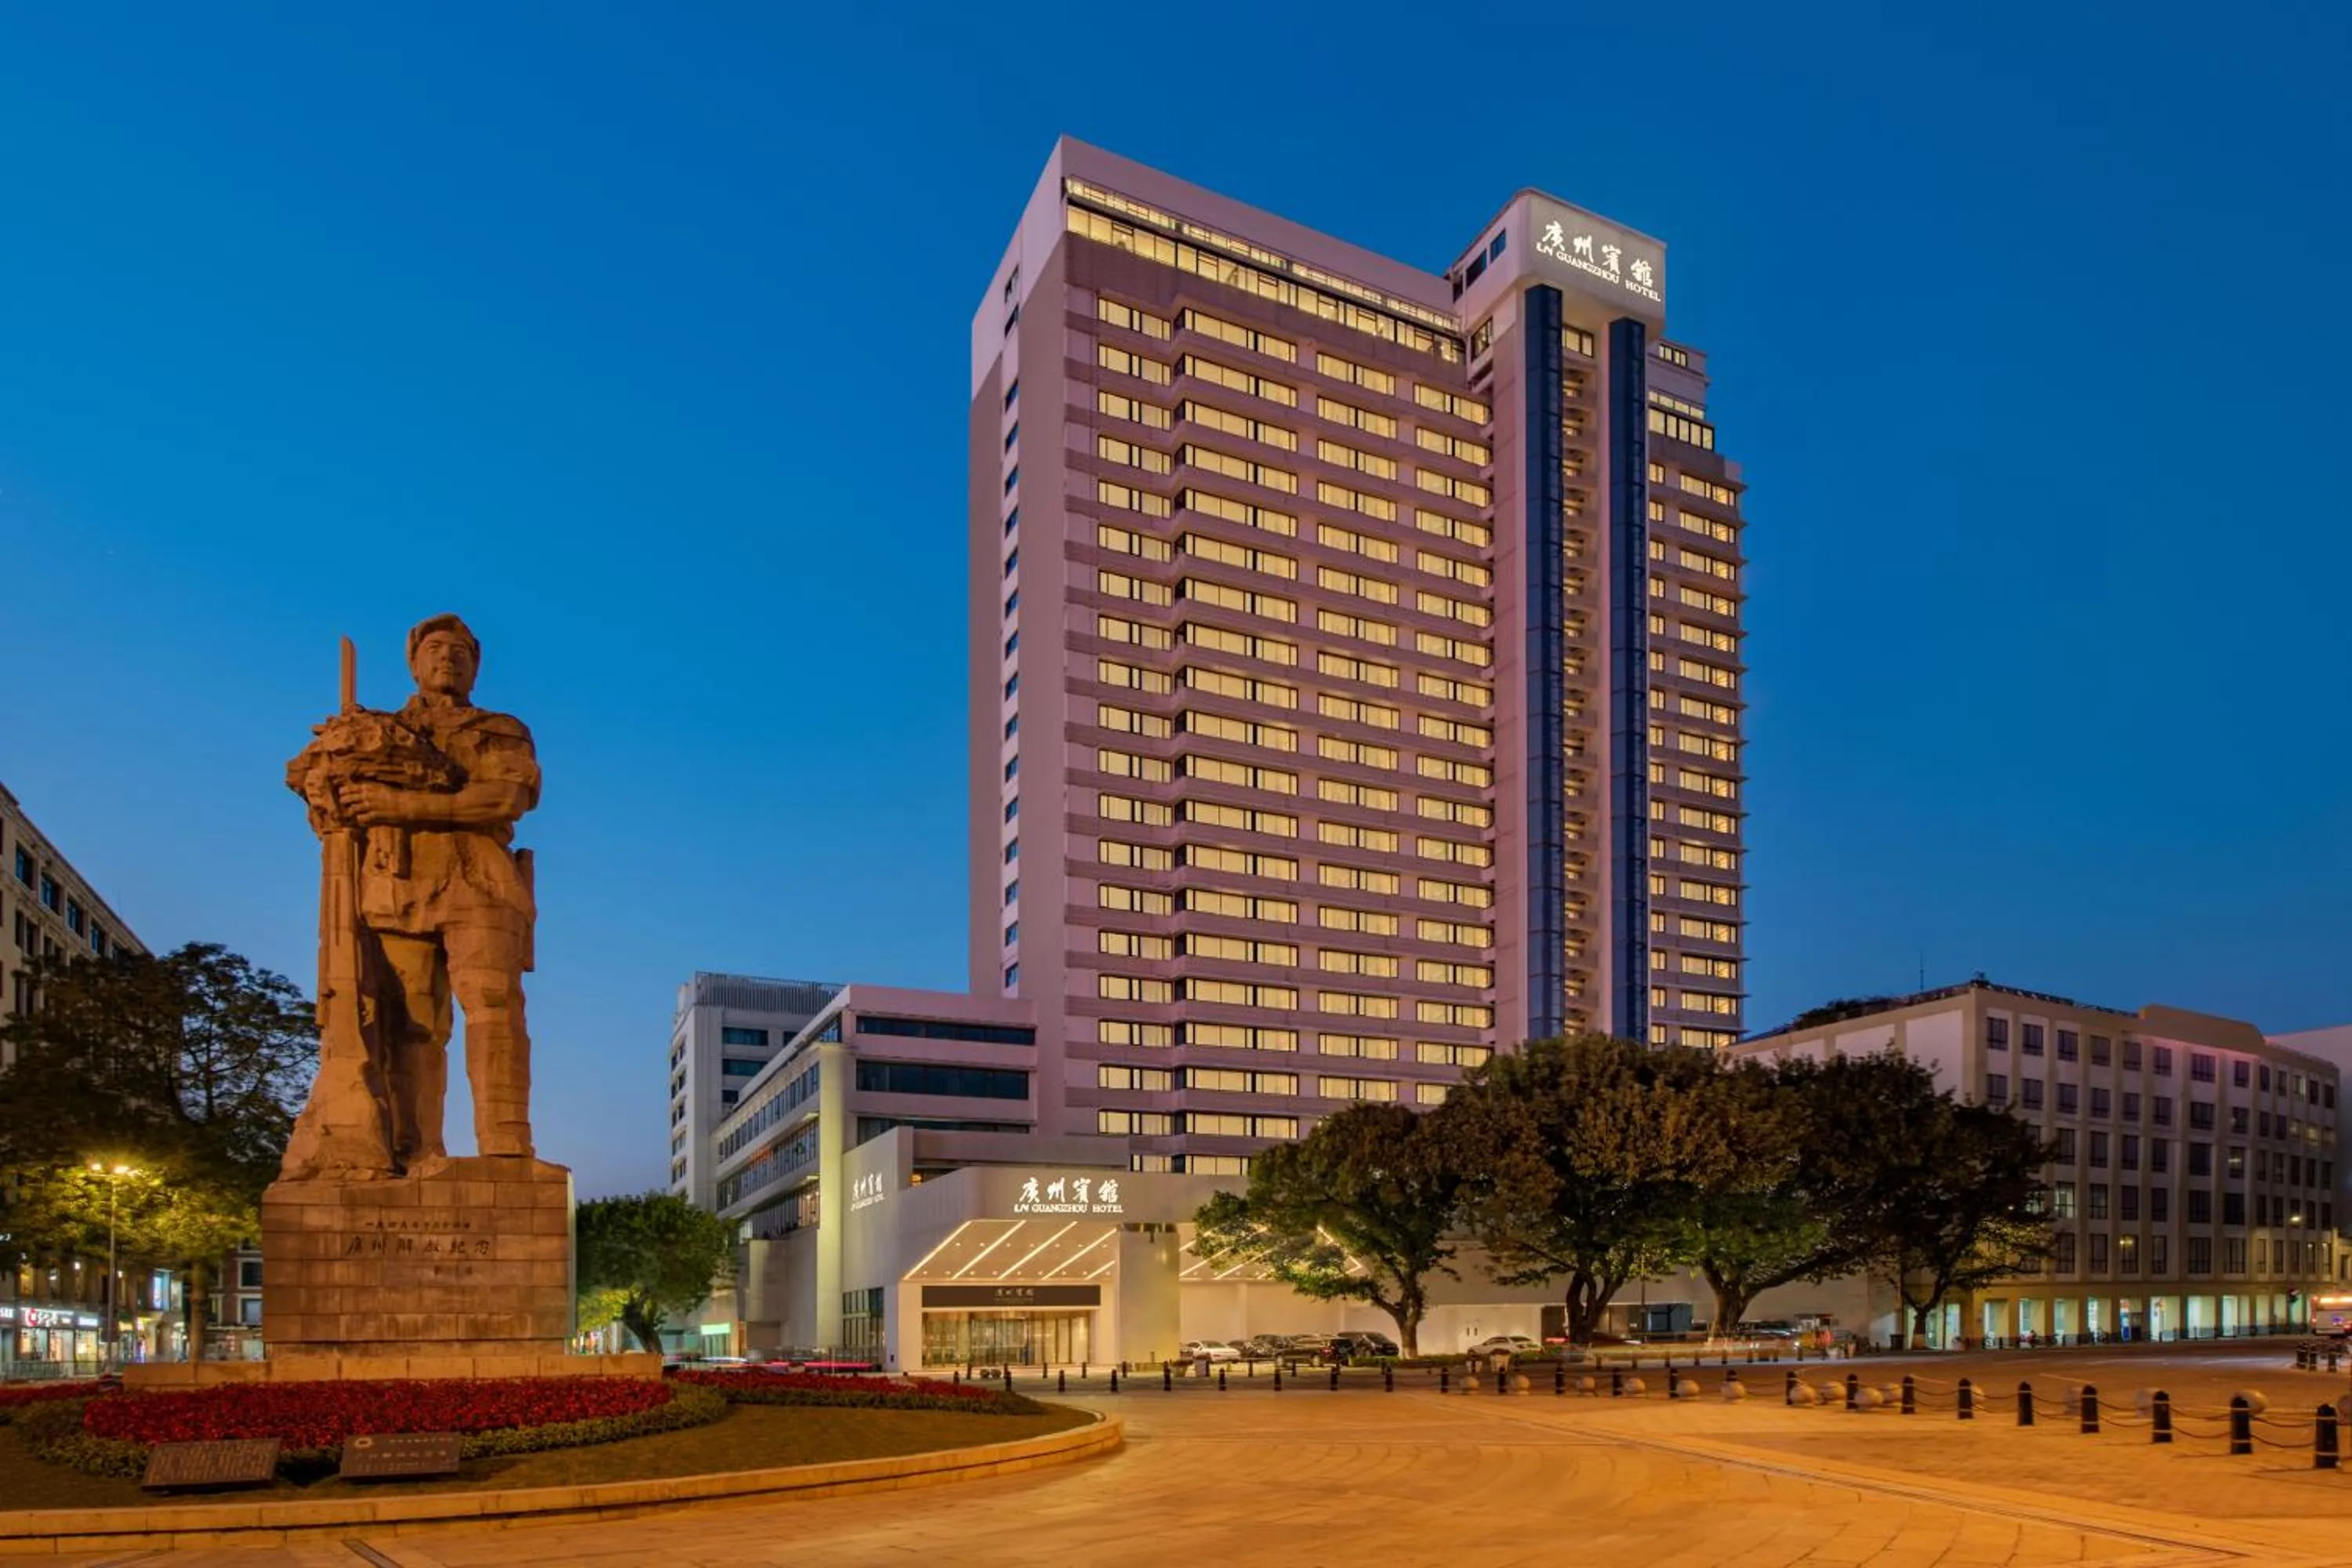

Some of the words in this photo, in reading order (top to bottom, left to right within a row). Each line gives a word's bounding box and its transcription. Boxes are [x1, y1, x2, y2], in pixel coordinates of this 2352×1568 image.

[1556, 251, 1620, 284] GUANGZHOU
[1625, 279, 1661, 302] HOTEL
[1031, 1203, 1087, 1213] GUANGZHOU
[1092, 1204, 1123, 1213] HOTEL
